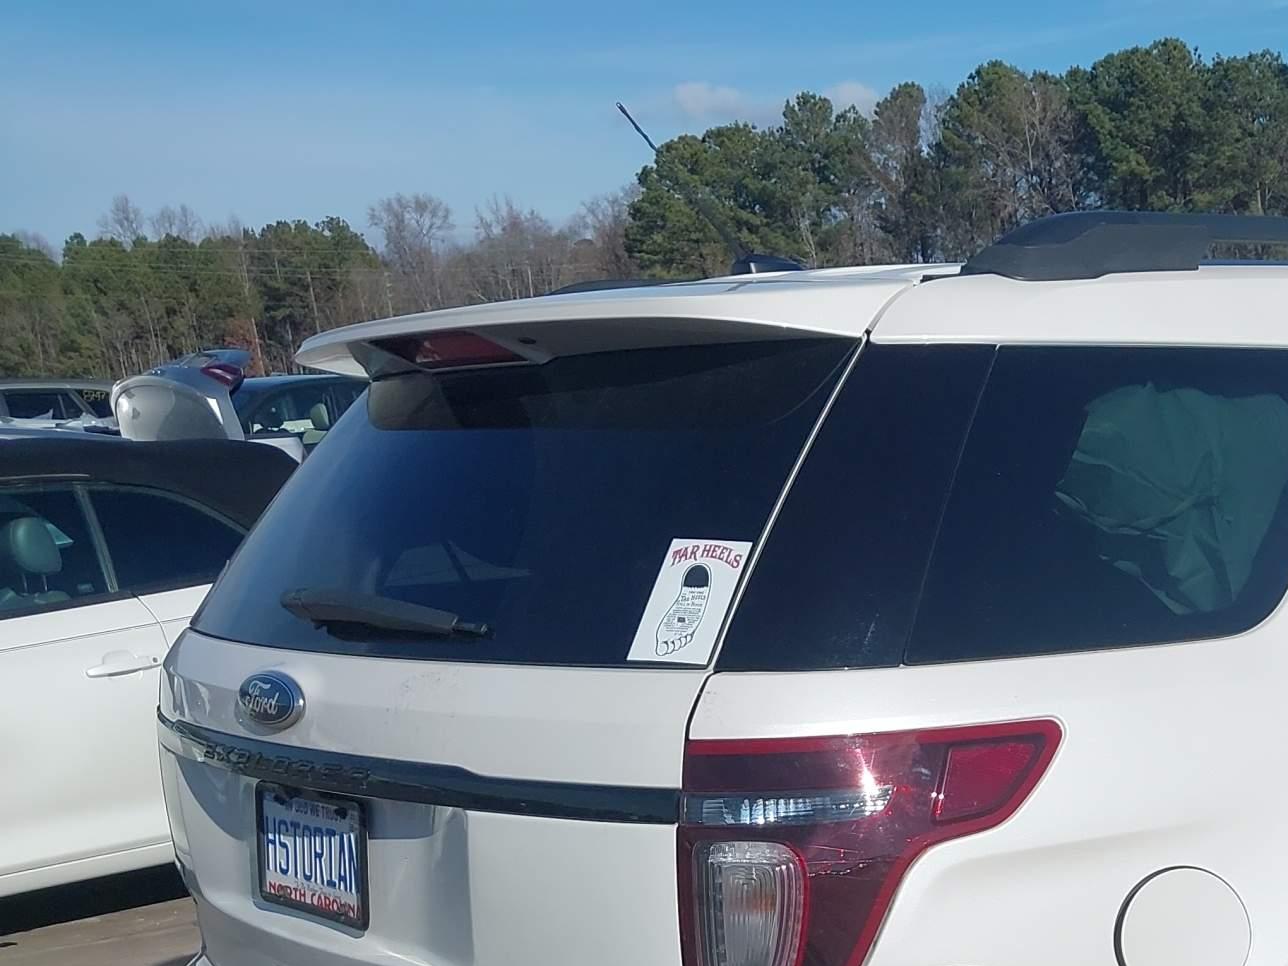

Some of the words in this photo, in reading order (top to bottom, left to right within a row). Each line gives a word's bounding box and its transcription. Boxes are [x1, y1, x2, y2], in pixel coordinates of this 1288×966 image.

[671, 545, 700, 567] TAR
[701, 543, 743, 569] HEELS
[246, 679, 280, 715] Ford
[264, 815, 361, 895] HSTORIAN
